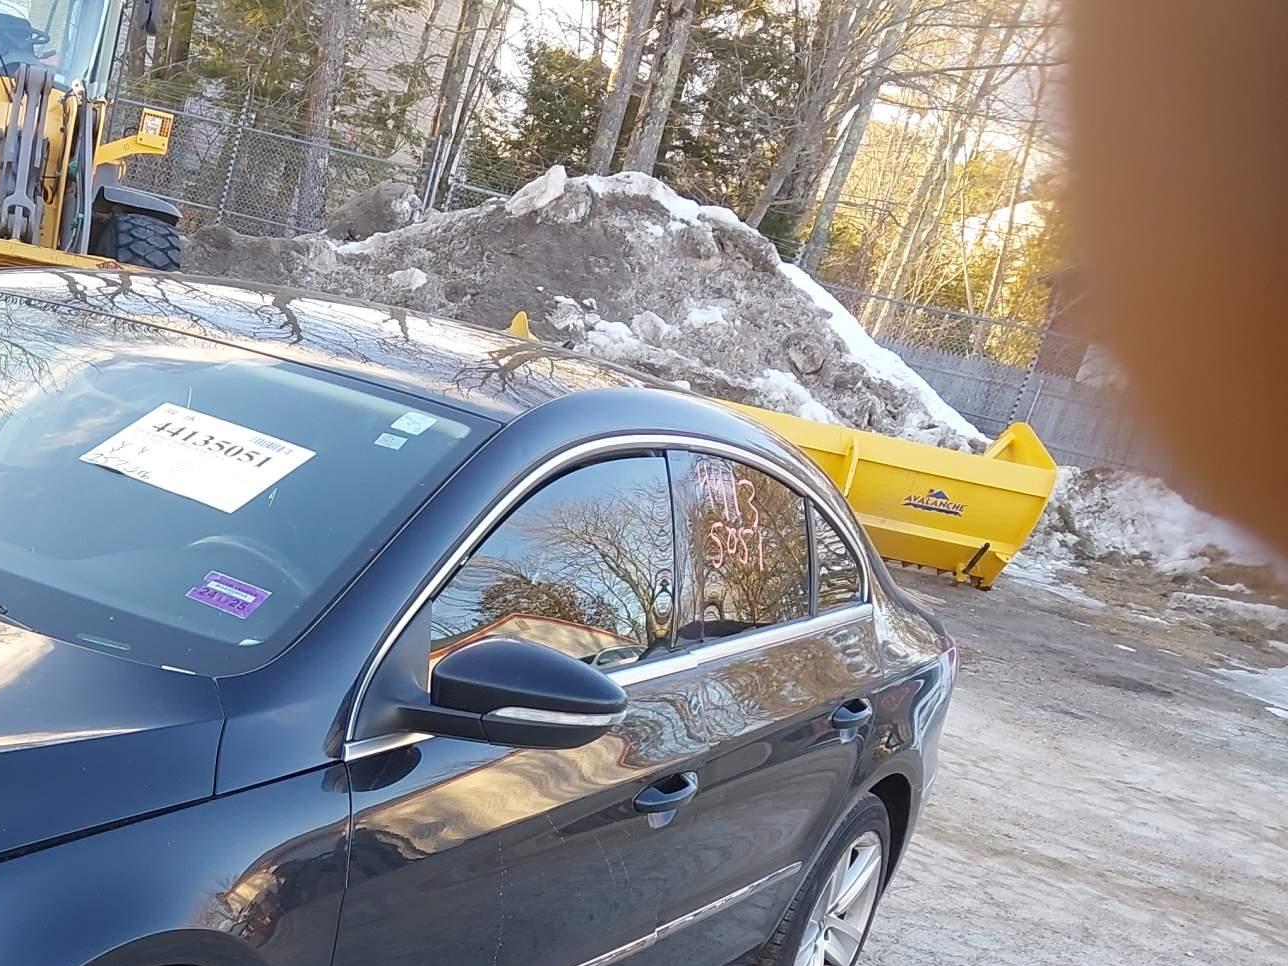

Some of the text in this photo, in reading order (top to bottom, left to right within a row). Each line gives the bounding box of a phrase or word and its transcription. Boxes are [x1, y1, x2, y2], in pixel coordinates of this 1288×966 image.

[151, 421, 273, 468] 44135051
[903, 494, 966, 513] AVALANCHE
[709, 521, 764, 571] 5051
[228, 599, 249, 611] 25
